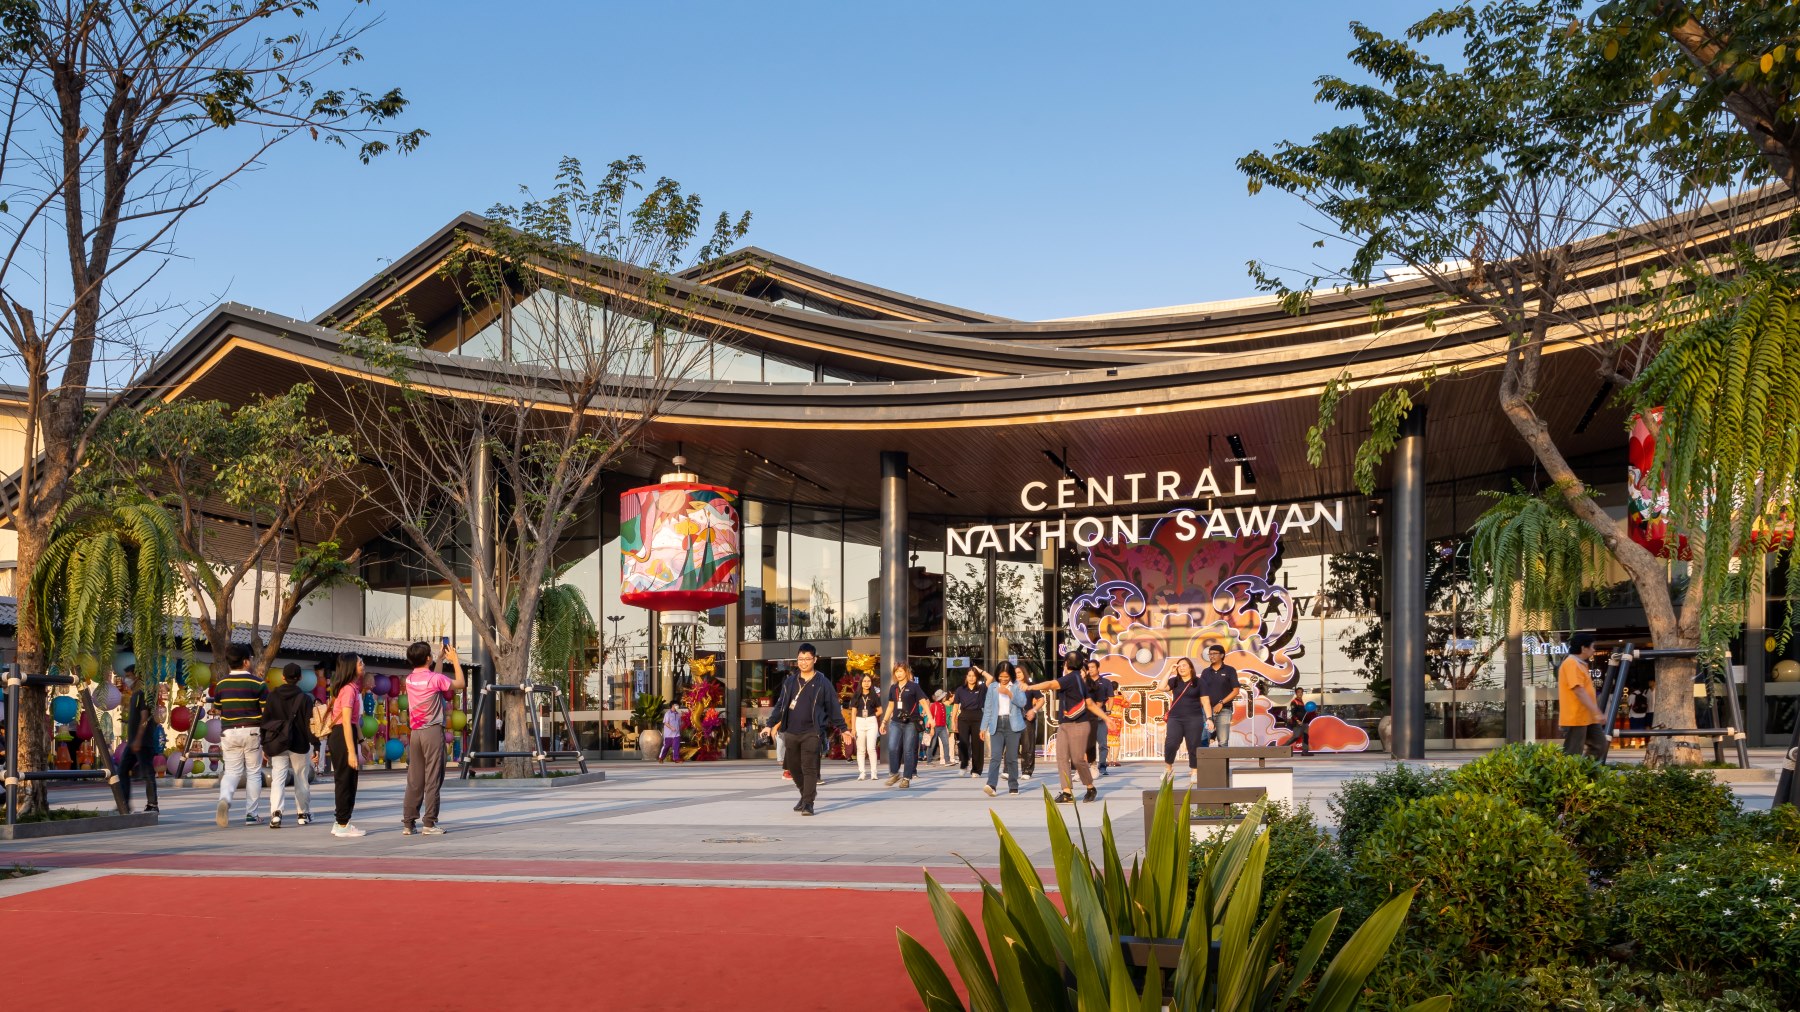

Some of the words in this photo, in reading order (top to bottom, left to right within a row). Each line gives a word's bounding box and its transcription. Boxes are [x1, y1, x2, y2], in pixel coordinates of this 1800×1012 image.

[1020, 465, 1256, 512] CENTRAL
[946, 513, 1139, 556] NAKHON
[1174, 500, 1343, 542] SAWAN
